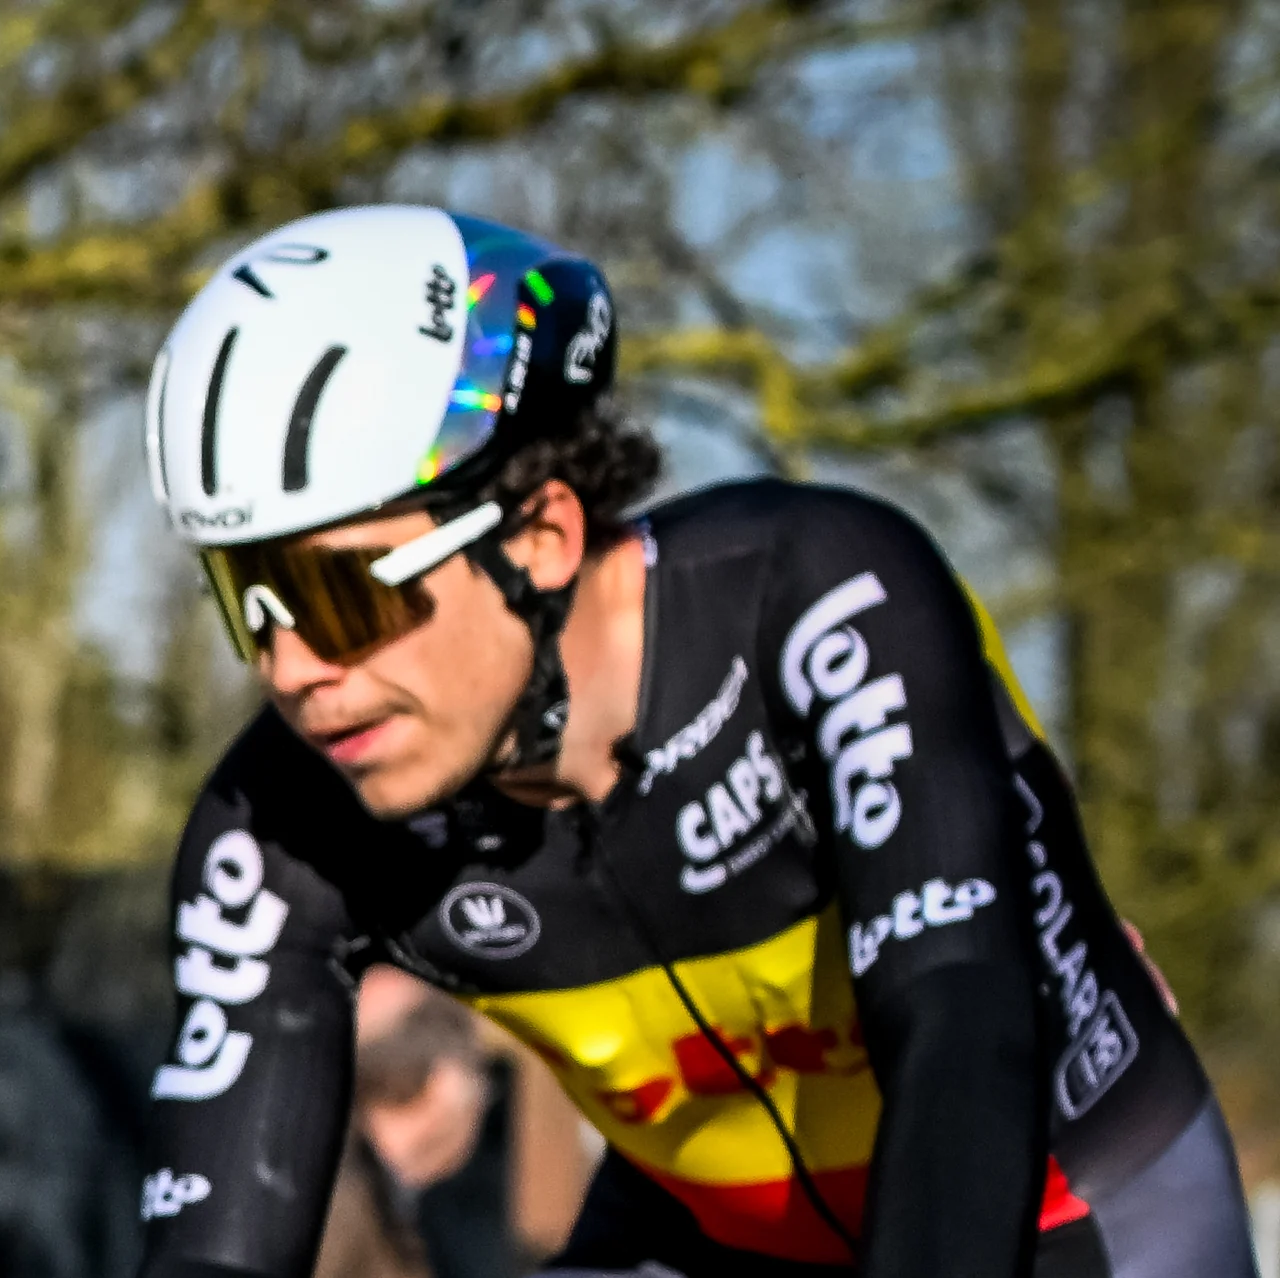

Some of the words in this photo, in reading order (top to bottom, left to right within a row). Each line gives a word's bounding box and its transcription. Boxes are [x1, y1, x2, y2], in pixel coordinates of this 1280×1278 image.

[675, 729, 784, 864] CAPS
[779, 570, 914, 850] lotto
[151, 827, 290, 1100] lotto
